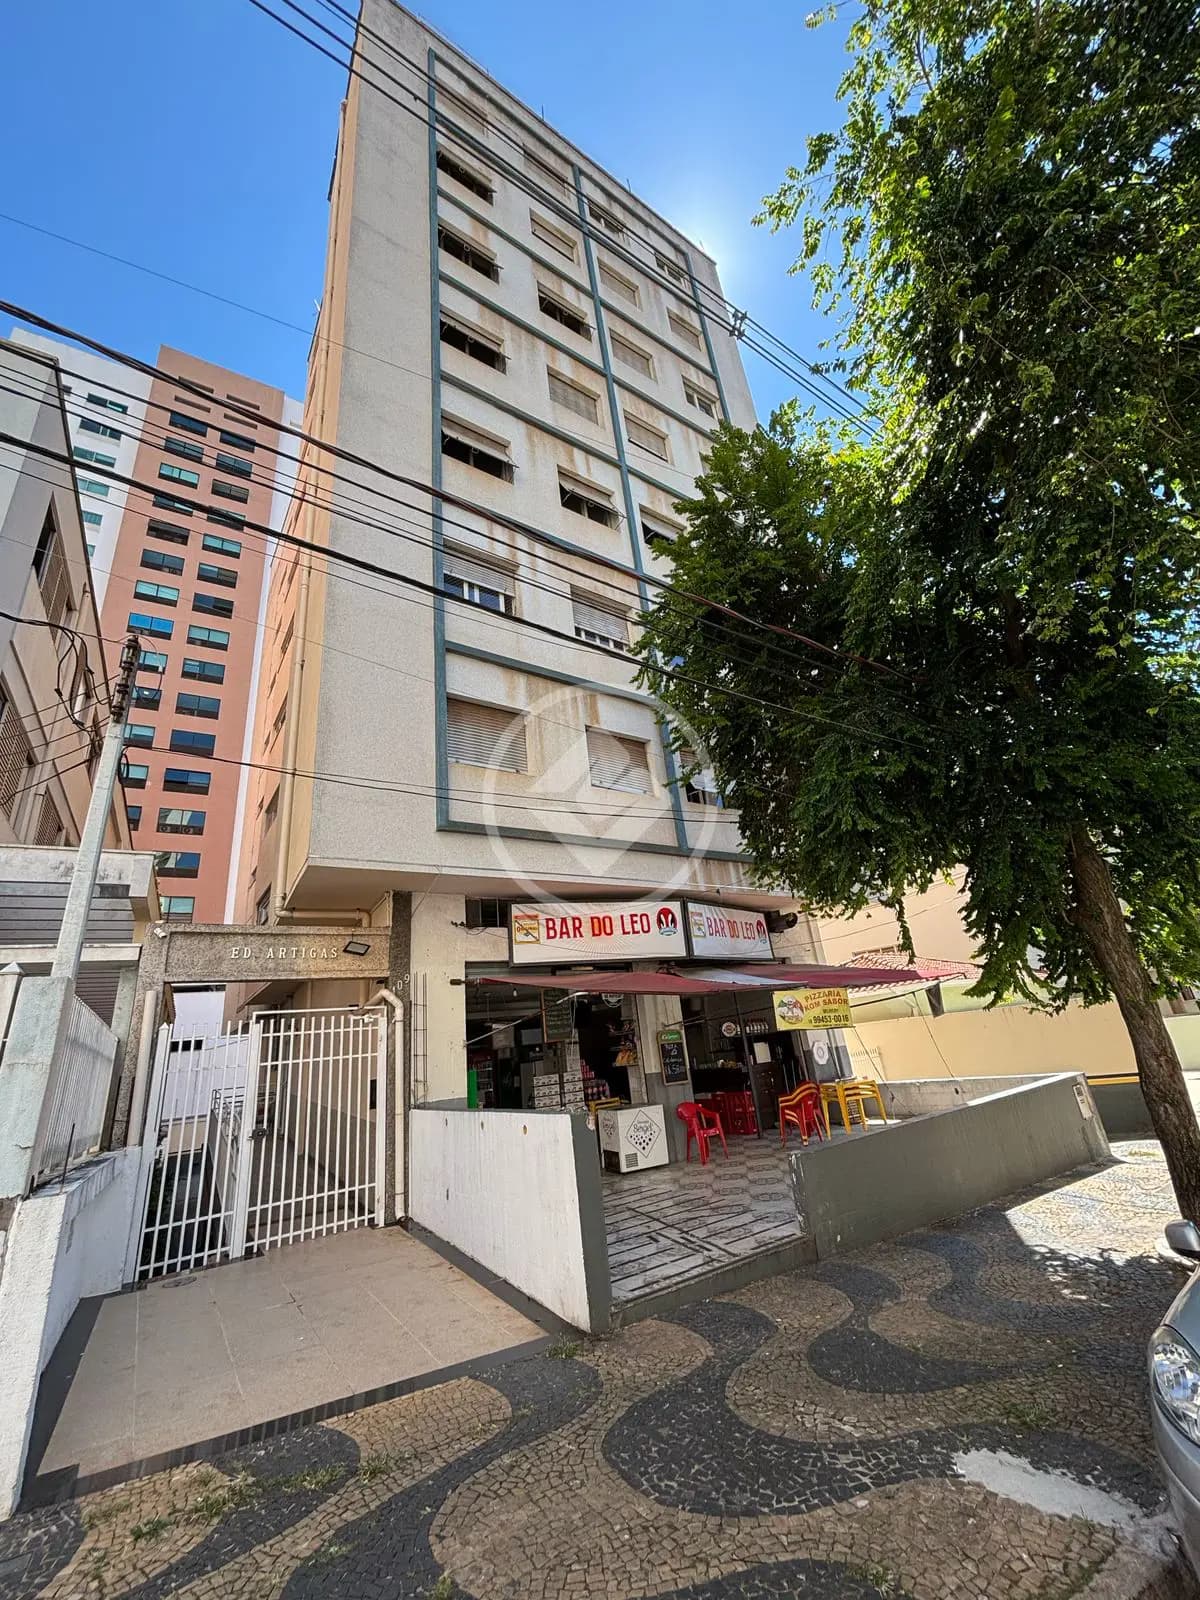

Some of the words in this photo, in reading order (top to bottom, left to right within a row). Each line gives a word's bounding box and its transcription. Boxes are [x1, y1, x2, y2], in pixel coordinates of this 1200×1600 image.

[545, 916, 584, 939] BAR
[590, 915, 614, 937] DO
[621, 913, 651, 935] LEO
[706, 917, 727, 937] BAR
[727, 919, 740, 938] DO
[741, 921, 756, 940] LEO
[266, 947, 337, 959] ARTIGAS
[805, 990, 841, 1003] PIZZARIA
[823, 998, 849, 1006] SABOR
